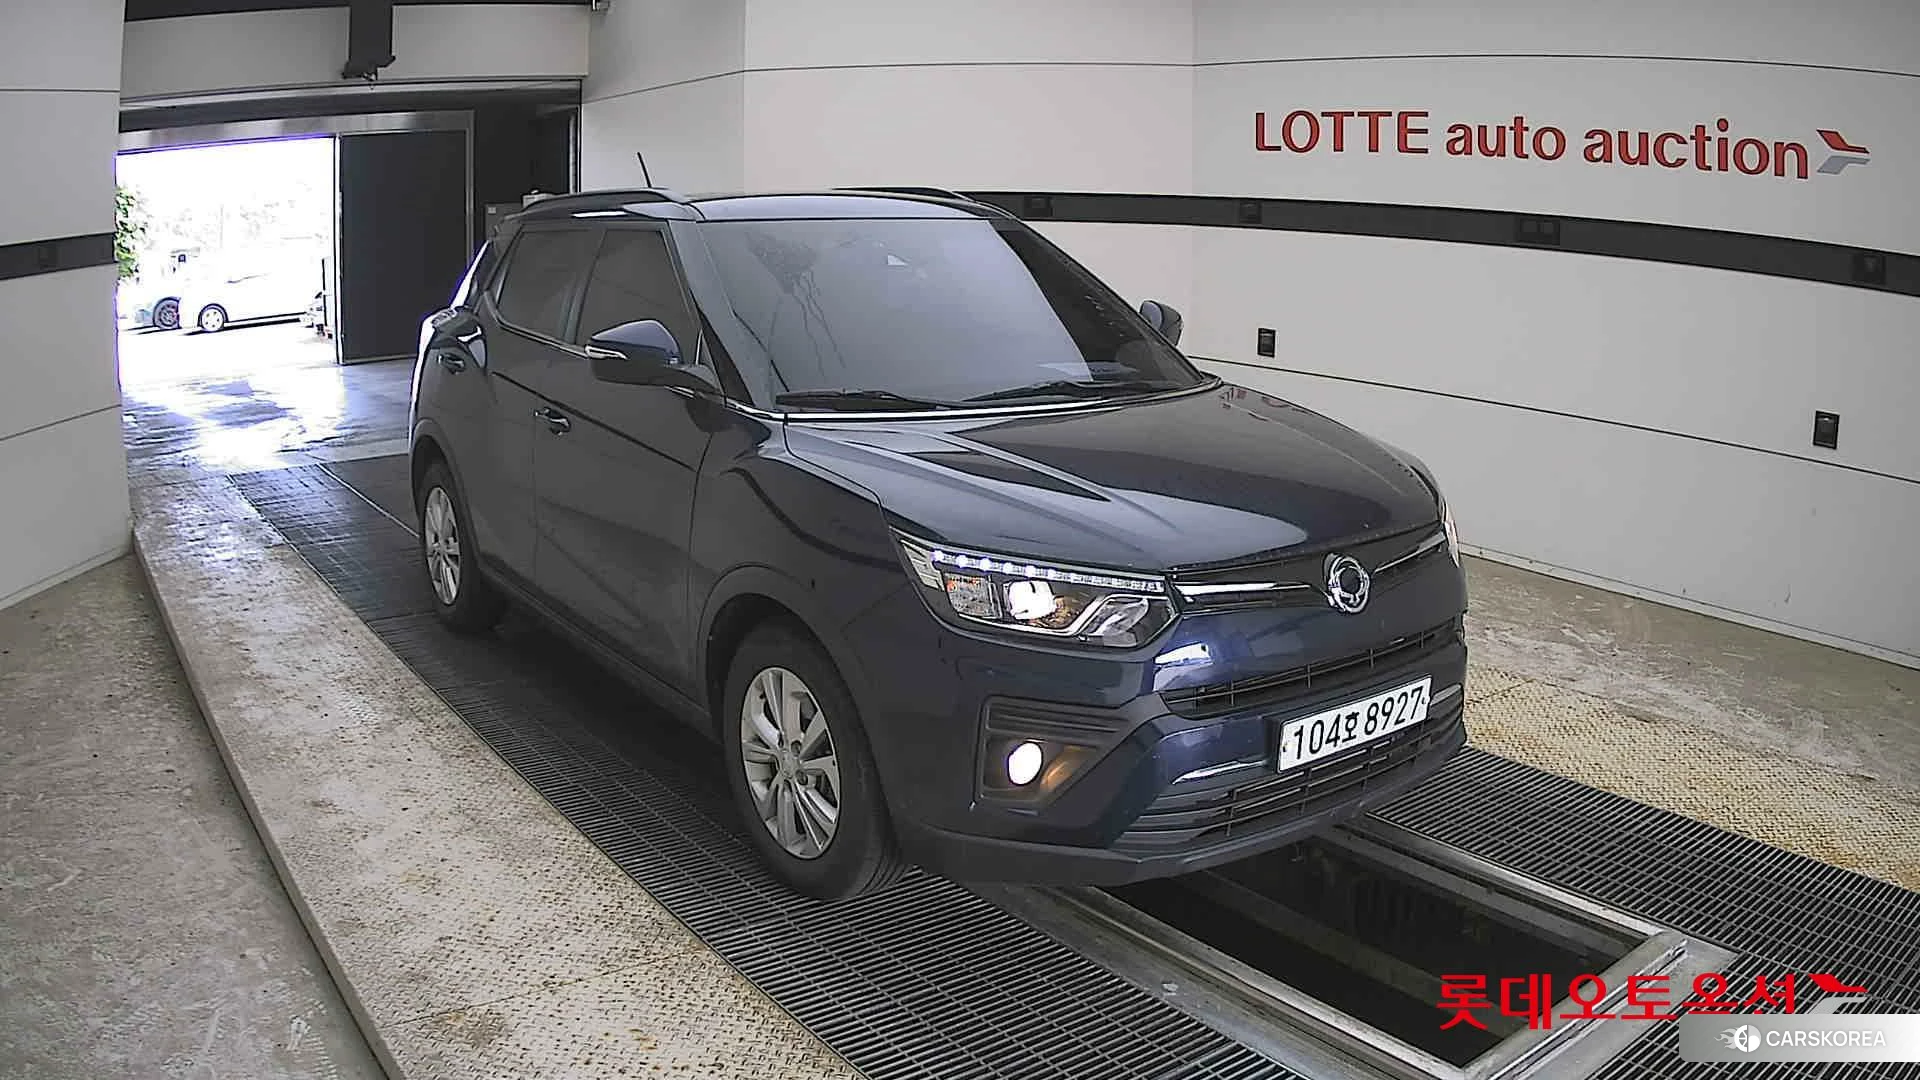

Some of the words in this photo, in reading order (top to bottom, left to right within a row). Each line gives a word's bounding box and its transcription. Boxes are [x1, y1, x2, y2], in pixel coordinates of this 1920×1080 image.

[1255, 110, 1430, 154] LOTTE
[1445, 116, 1567, 161] auto
[1583, 117, 1809, 180] auction
[1364, 686, 1424, 735] 8927
